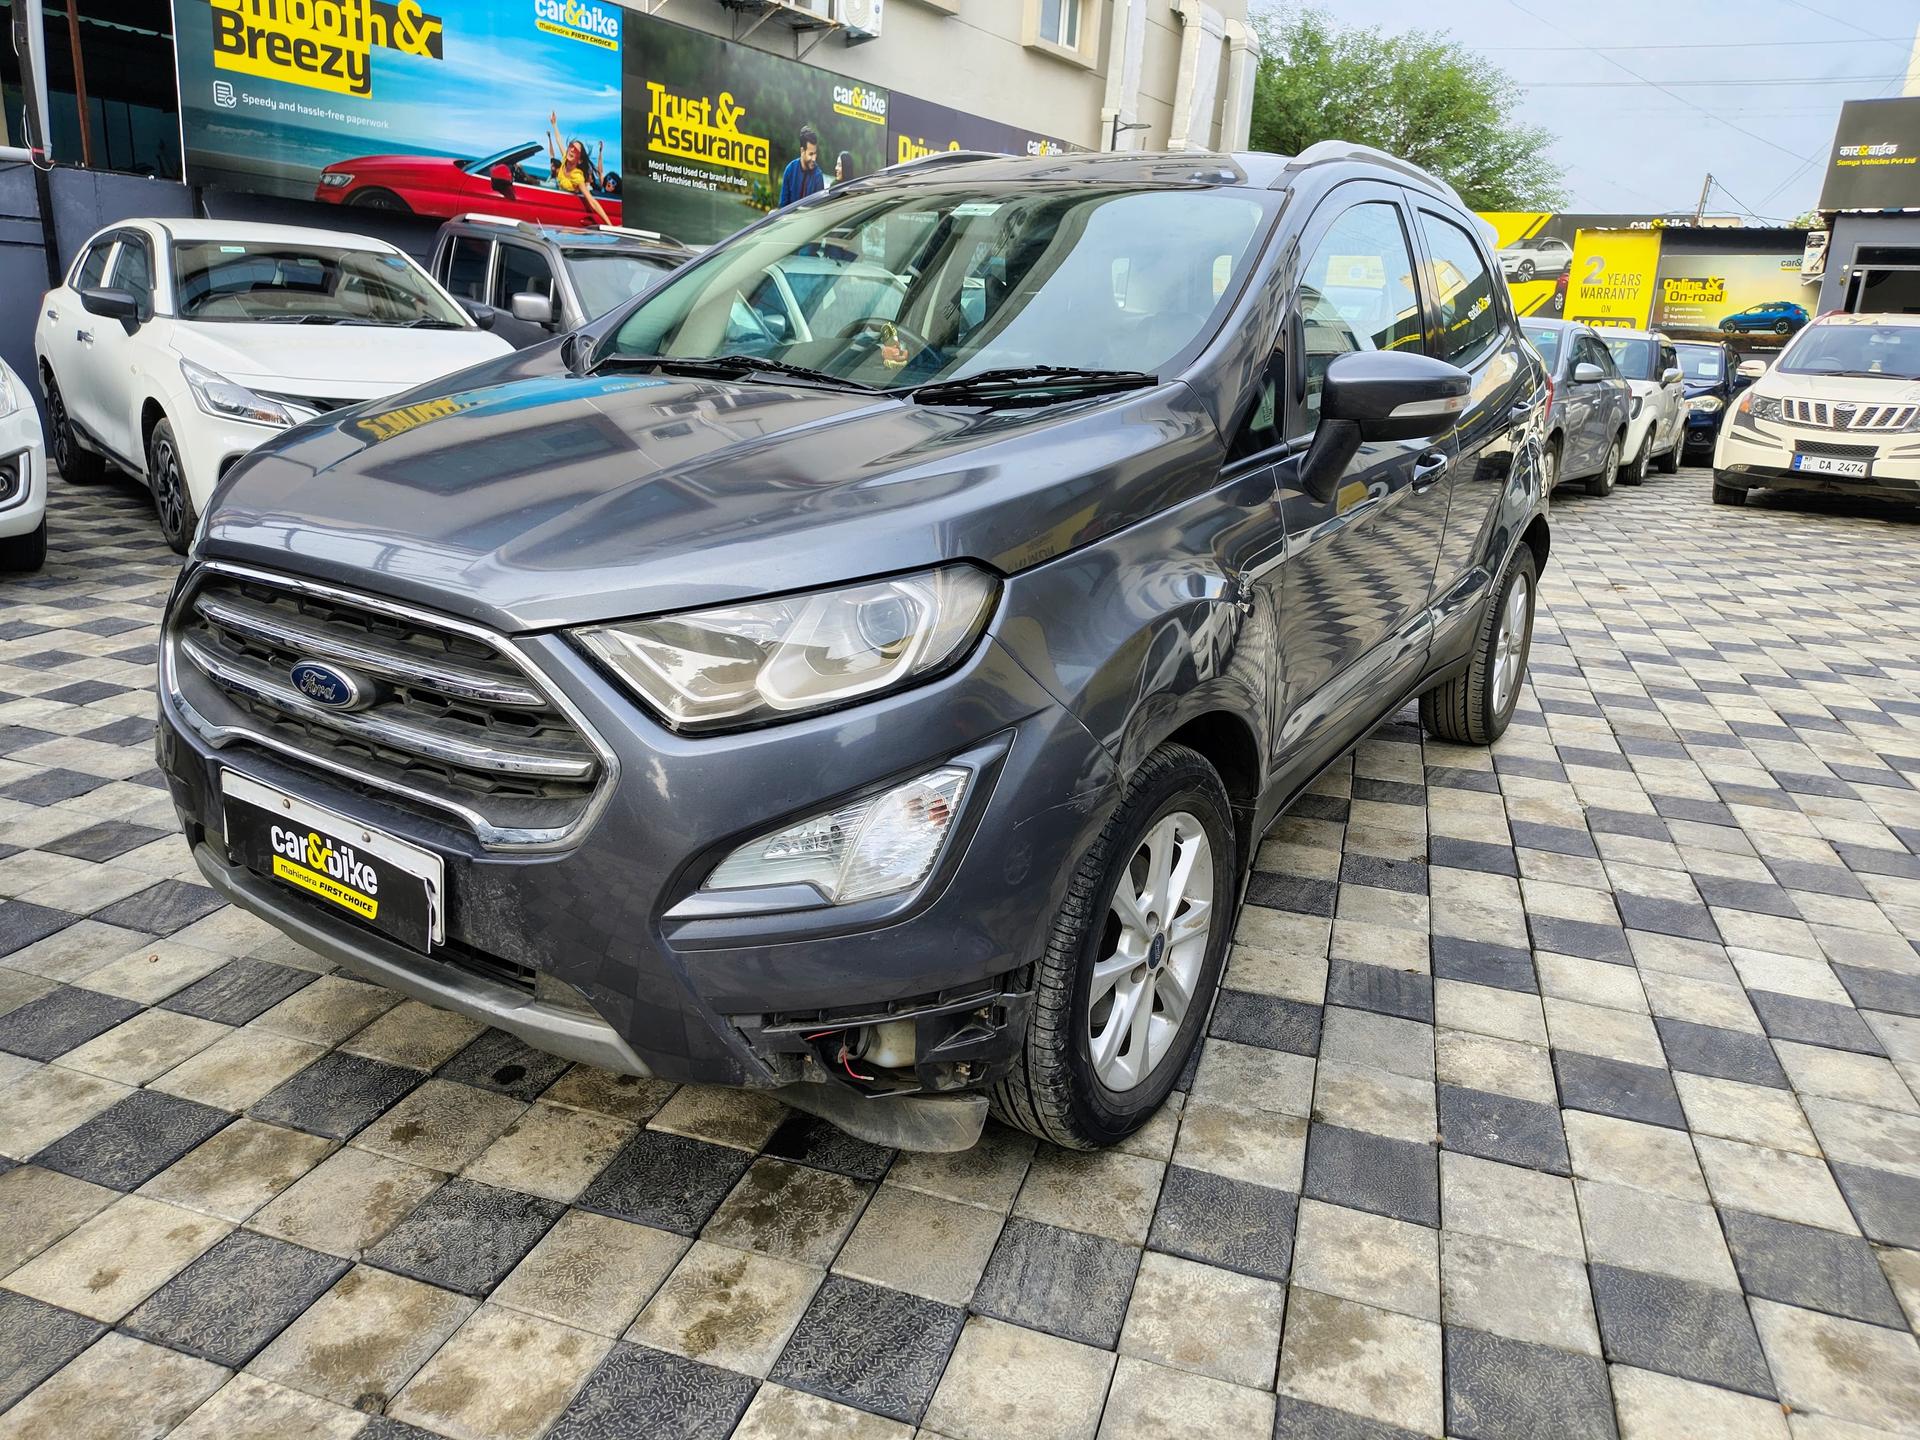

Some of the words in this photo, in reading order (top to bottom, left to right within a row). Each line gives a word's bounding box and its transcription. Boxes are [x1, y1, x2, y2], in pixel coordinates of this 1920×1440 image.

[211, 0, 387, 47] mooth
[211, 6, 372, 94] Breezy
[571, 31, 589, 42] FIRST
[590, 36, 612, 47] CHOICE
[242, 93, 277, 111] Speedy
[278, 99, 296, 112] and
[297, 101, 345, 122] hassle-free
[346, 114, 389, 129] paperwork
[646, 81, 712, 128] Trust
[716, 91, 746, 134] &
[833, 85, 886, 115] car&bike
[648, 114, 767, 168] Assurance
[898, 135, 942, 164] Dri
[648, 160, 664, 171] Most
[665, 163, 682, 174] loved
[682, 166, 698, 177] Used
[699, 170, 709, 179] Car
[709, 172, 726, 183] brand
[727, 175, 734, 184] of
[734, 176, 748, 187] India
[652, 172, 662, 183] By
[662, 173, 691, 187] Franchise
[709, 182, 718, 191] ET
[1583, 255, 1605, 285] 2
[1607, 273, 1642, 286] YEARS
[1663, 278, 1703, 291] Online
[1580, 287, 1640, 300] WARRANTY
[1601, 304, 1612, 313] ON
[1669, 291, 1723, 302] On-road
[1819, 460, 1832, 470] CA
[1837, 462, 1864, 473] 2474
[300, 669, 336, 700] Ford
[271, 825, 378, 895] car&bike
[319, 882, 342, 898] FIRST
[343, 893, 373, 912] CHOICE
